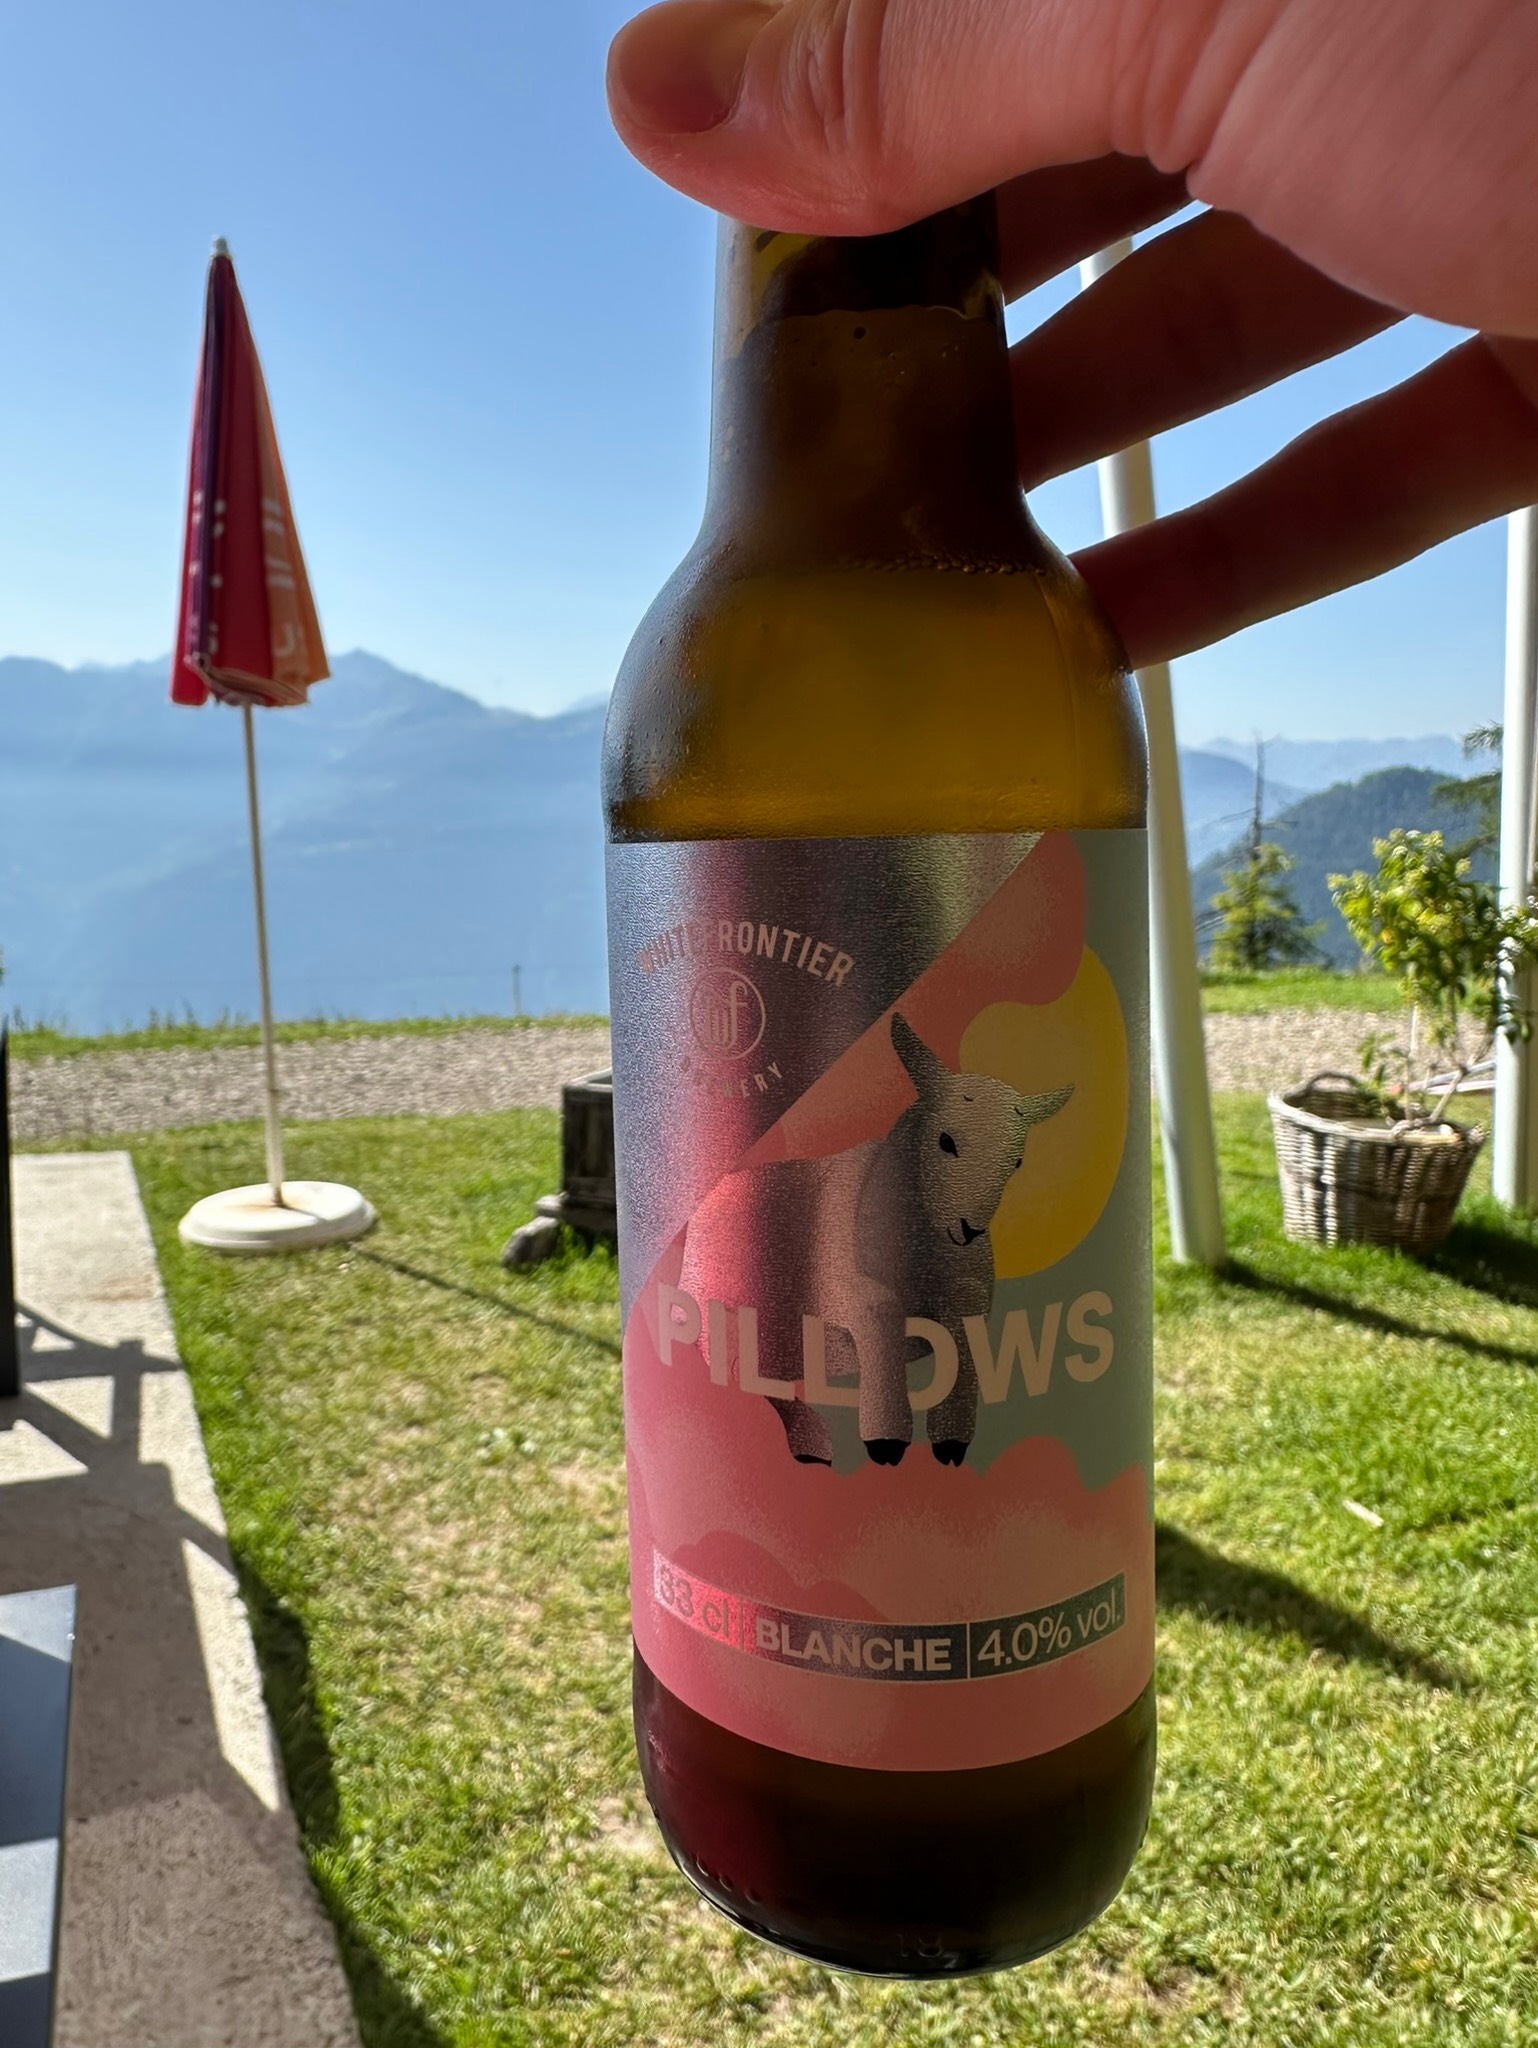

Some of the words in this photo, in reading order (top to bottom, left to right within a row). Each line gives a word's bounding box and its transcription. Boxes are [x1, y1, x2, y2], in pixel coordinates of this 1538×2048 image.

[657, 1281, 1114, 1411] PILLOWS
[659, 1564, 695, 1617] 33
[701, 1598, 730, 1639] cl
[756, 1618, 952, 1672] BLANCHE
[976, 1612, 1072, 1667] 4.0%
[1078, 1599, 1124, 1640] vol.
